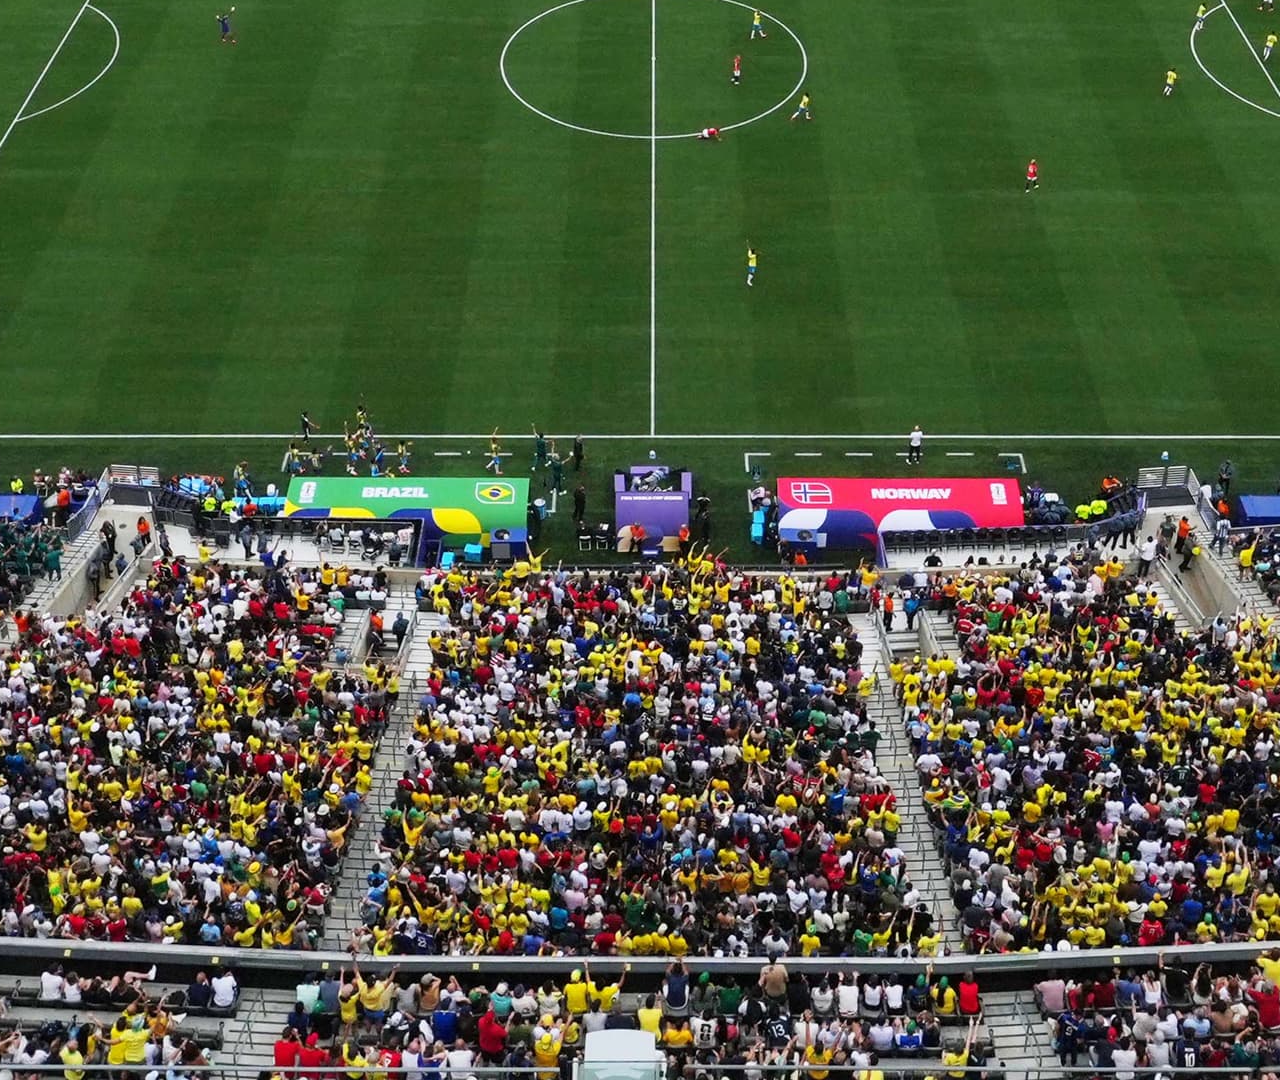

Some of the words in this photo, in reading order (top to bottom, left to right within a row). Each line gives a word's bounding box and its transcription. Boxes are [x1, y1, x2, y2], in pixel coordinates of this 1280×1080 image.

[361, 487, 430, 499] BRAZIL
[871, 488, 952, 500] NORWAY
[773, 1024, 785, 1038] 13
[1184, 1052, 1196, 1067] 10
